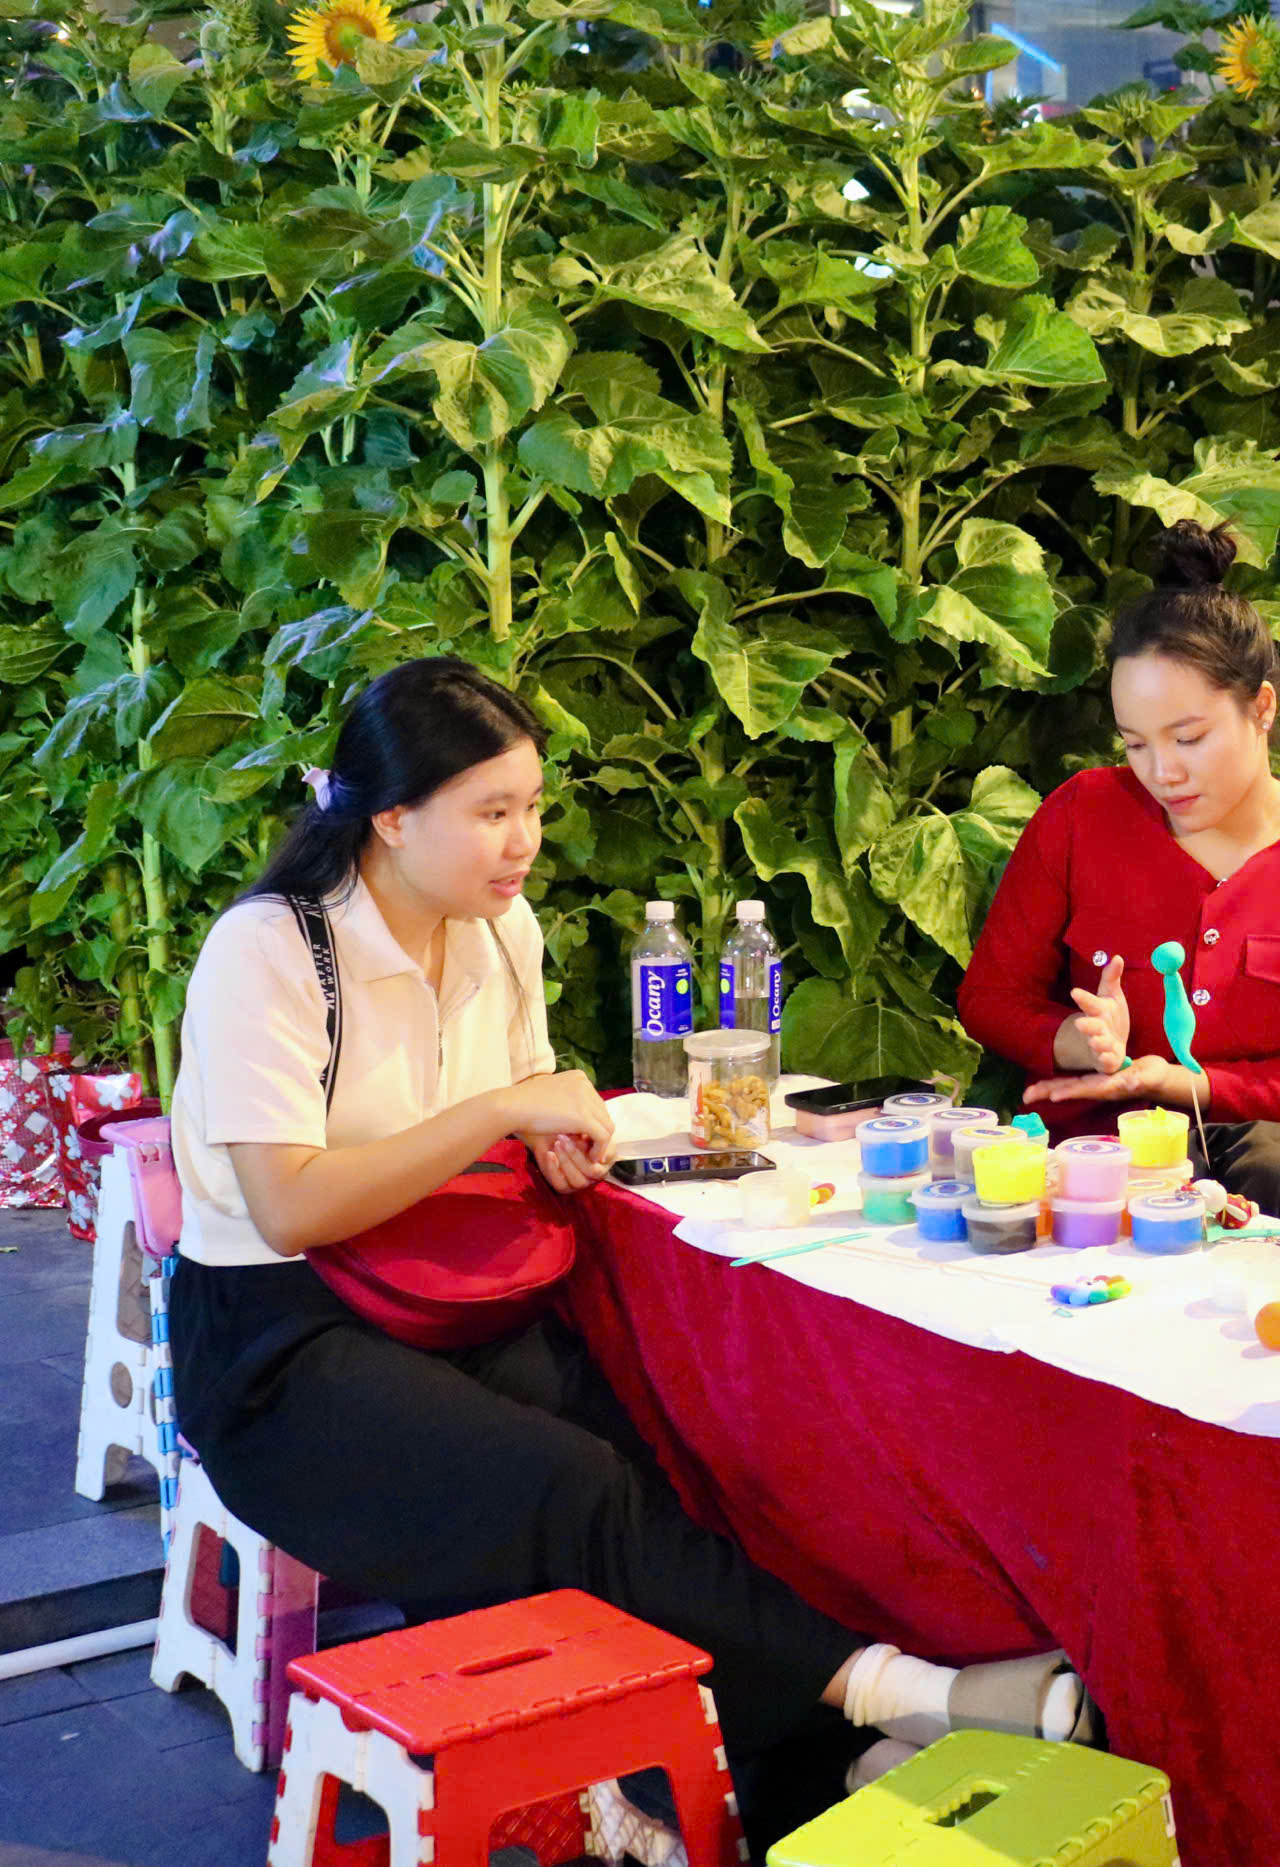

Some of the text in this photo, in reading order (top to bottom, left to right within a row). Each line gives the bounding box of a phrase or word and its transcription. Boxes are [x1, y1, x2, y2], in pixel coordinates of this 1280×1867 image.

[312, 944, 326, 986] AFTER
[323, 948, 334, 985] WORK
[646, 970, 666, 1036] Ocany
[772, 969, 782, 1017] Ocany
